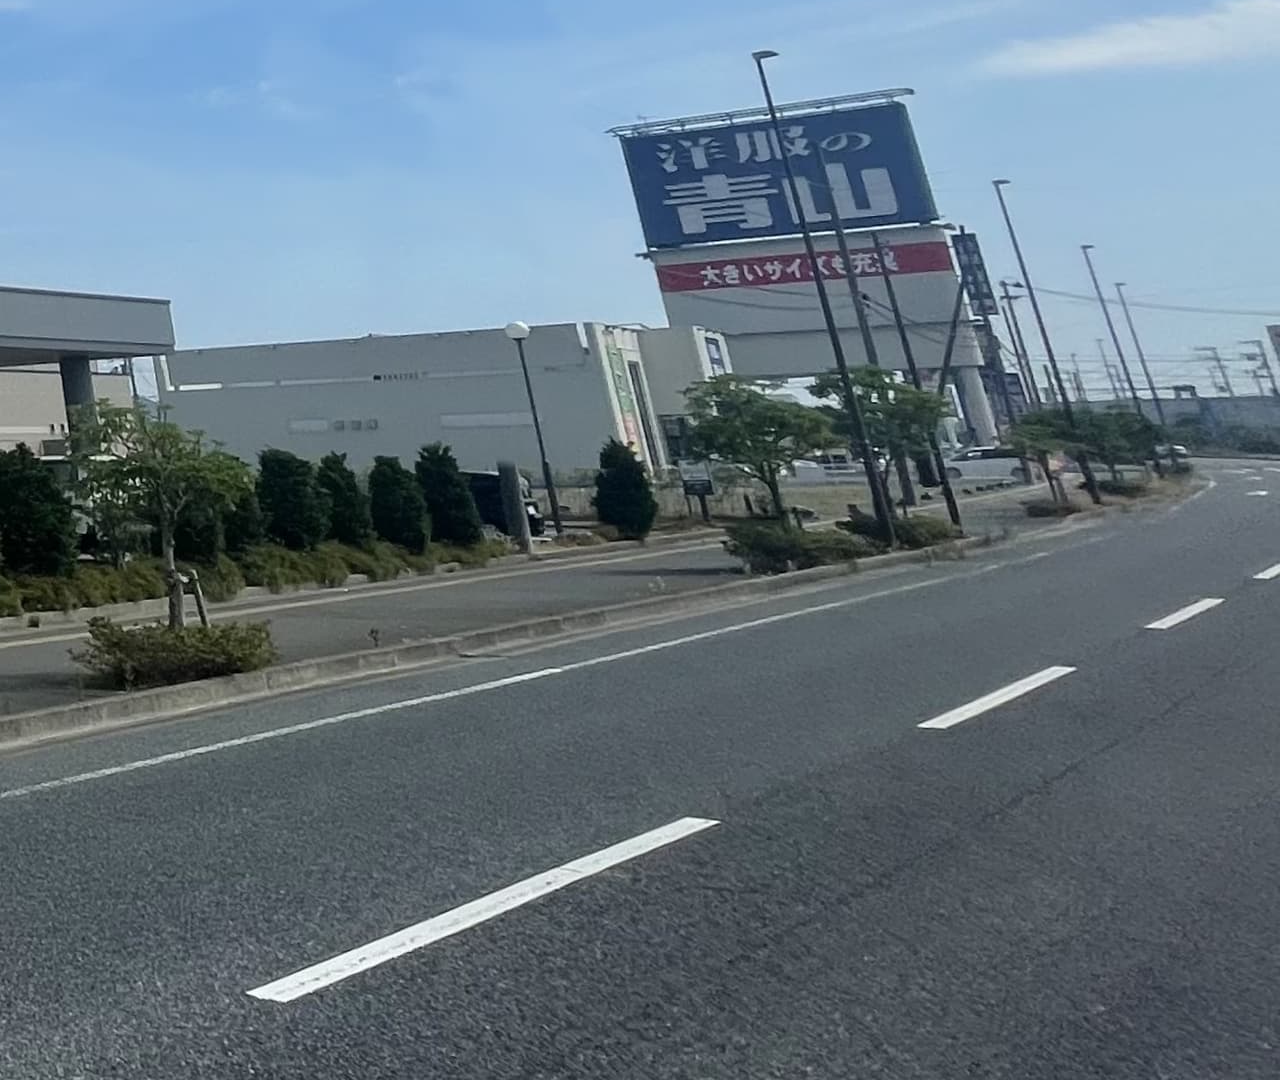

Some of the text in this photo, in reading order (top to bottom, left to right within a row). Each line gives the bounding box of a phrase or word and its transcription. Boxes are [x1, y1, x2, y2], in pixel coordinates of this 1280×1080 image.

[656, 124, 873, 173] 洋服の
[663, 162, 899, 236] 青山
